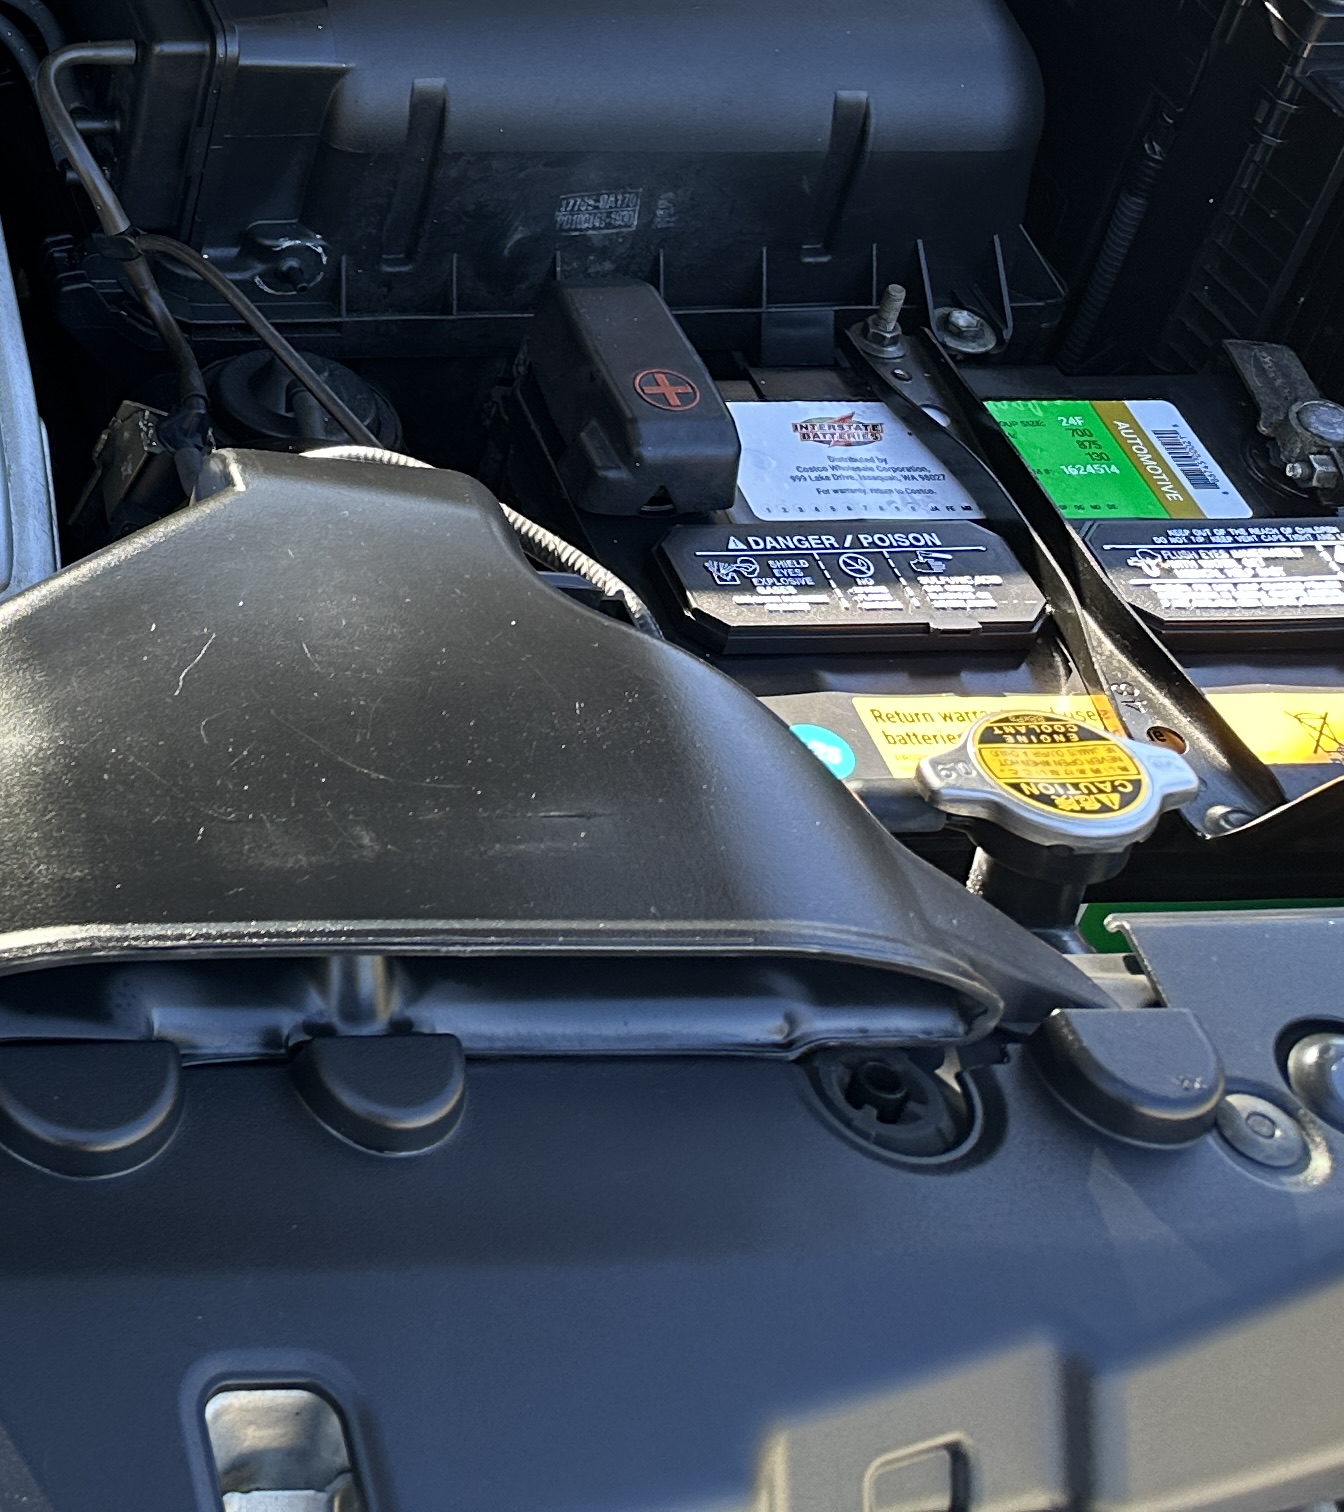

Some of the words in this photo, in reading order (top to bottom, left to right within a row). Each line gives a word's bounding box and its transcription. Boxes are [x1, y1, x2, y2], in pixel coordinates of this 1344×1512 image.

[1057, 416, 1084, 427] 24F
[793, 423, 882, 432] INTERSTATE
[802, 433, 882, 441] BATTERIES
[1068, 428, 1093, 438] 700
[1076, 439, 1102, 450] 875
[827, 455, 876, 464] Distributed
[876, 456, 888, 465] by
[1085, 451, 1110, 462] 130
[1113, 420, 1184, 503] AUTOMOTIVE
[1060, 464, 1120, 476] 1624514
[1167, 529, 1190, 537] KEEP
[1192, 529, 1212, 537] OUT
[1228, 528, 1248, 536] THE
[1249, 527, 1279, 536] REACH
[1280, 527, 1293, 535] OF
[747, 535, 839, 550] DANGER
[858, 532, 942, 548] POISON
[1152, 537, 1168, 545] DO
[1169, 536, 1187, 544] NOT
[1161, 550, 1200, 560] FLUSH
[1200, 550, 1230, 560] EYES
[767, 558, 809, 569] SHIELD
[772, 568, 804, 578] EYES
[752, 577, 816, 587] EXPLOSIVE
[856, 577, 874, 586] NO
[870, 709, 935, 724] Return
[993, 724, 1078, 734] COOLANT
[881, 729, 962, 746] batterie
[1003, 733, 1079, 743] ENGINE
[1052, 758, 1084, 766] OPEN
[1086, 755, 1123, 766] NEVER
[1020, 780, 1133, 795] CAUTION
